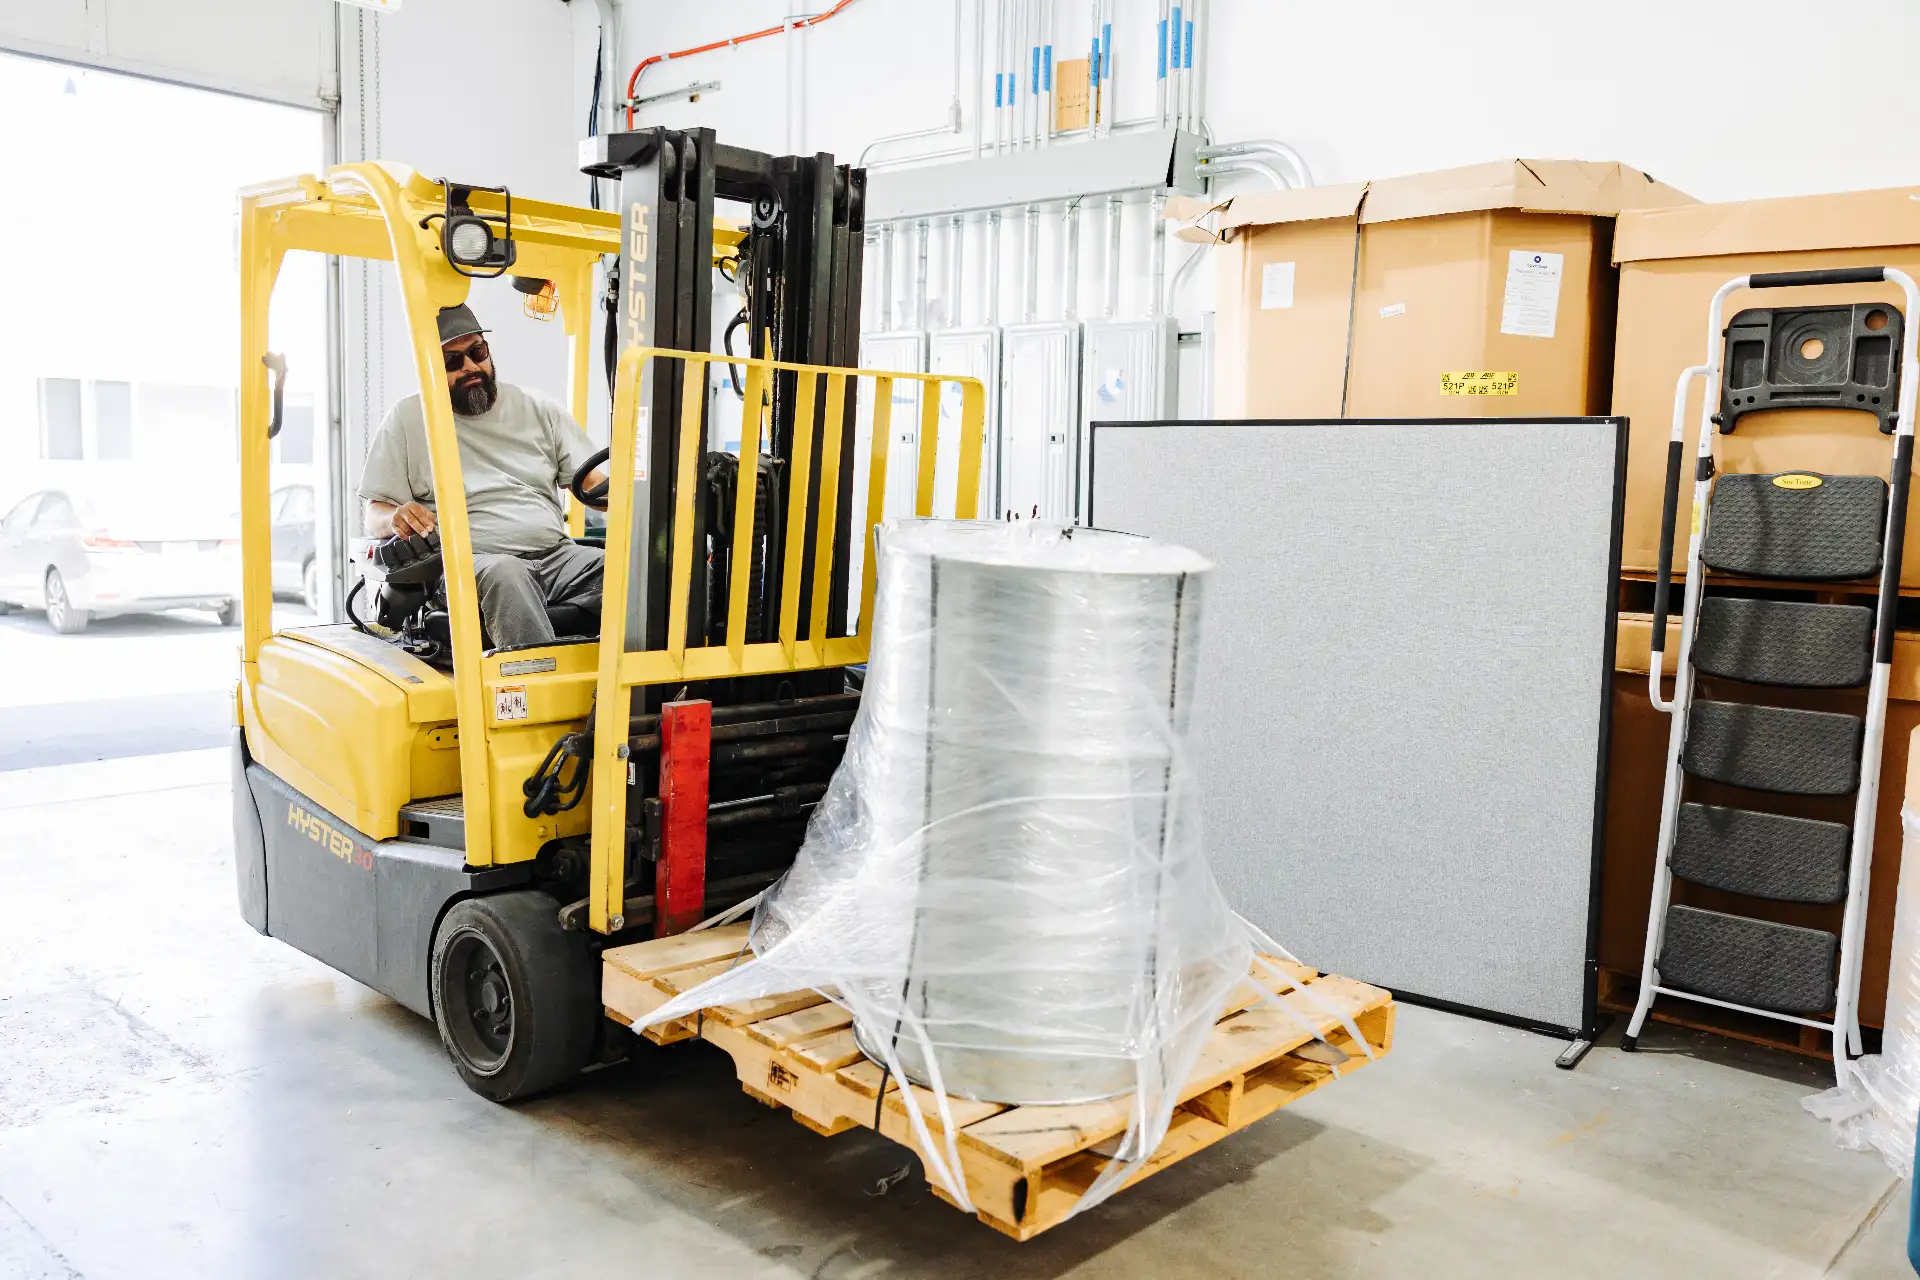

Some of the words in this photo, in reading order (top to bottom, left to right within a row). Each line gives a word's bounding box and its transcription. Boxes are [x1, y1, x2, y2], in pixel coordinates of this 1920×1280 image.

[627, 201, 649, 347] YSTER
[1443, 382, 1465, 390] 521P
[1491, 382, 1515, 390] 521P
[287, 802, 354, 864] HYSTER
